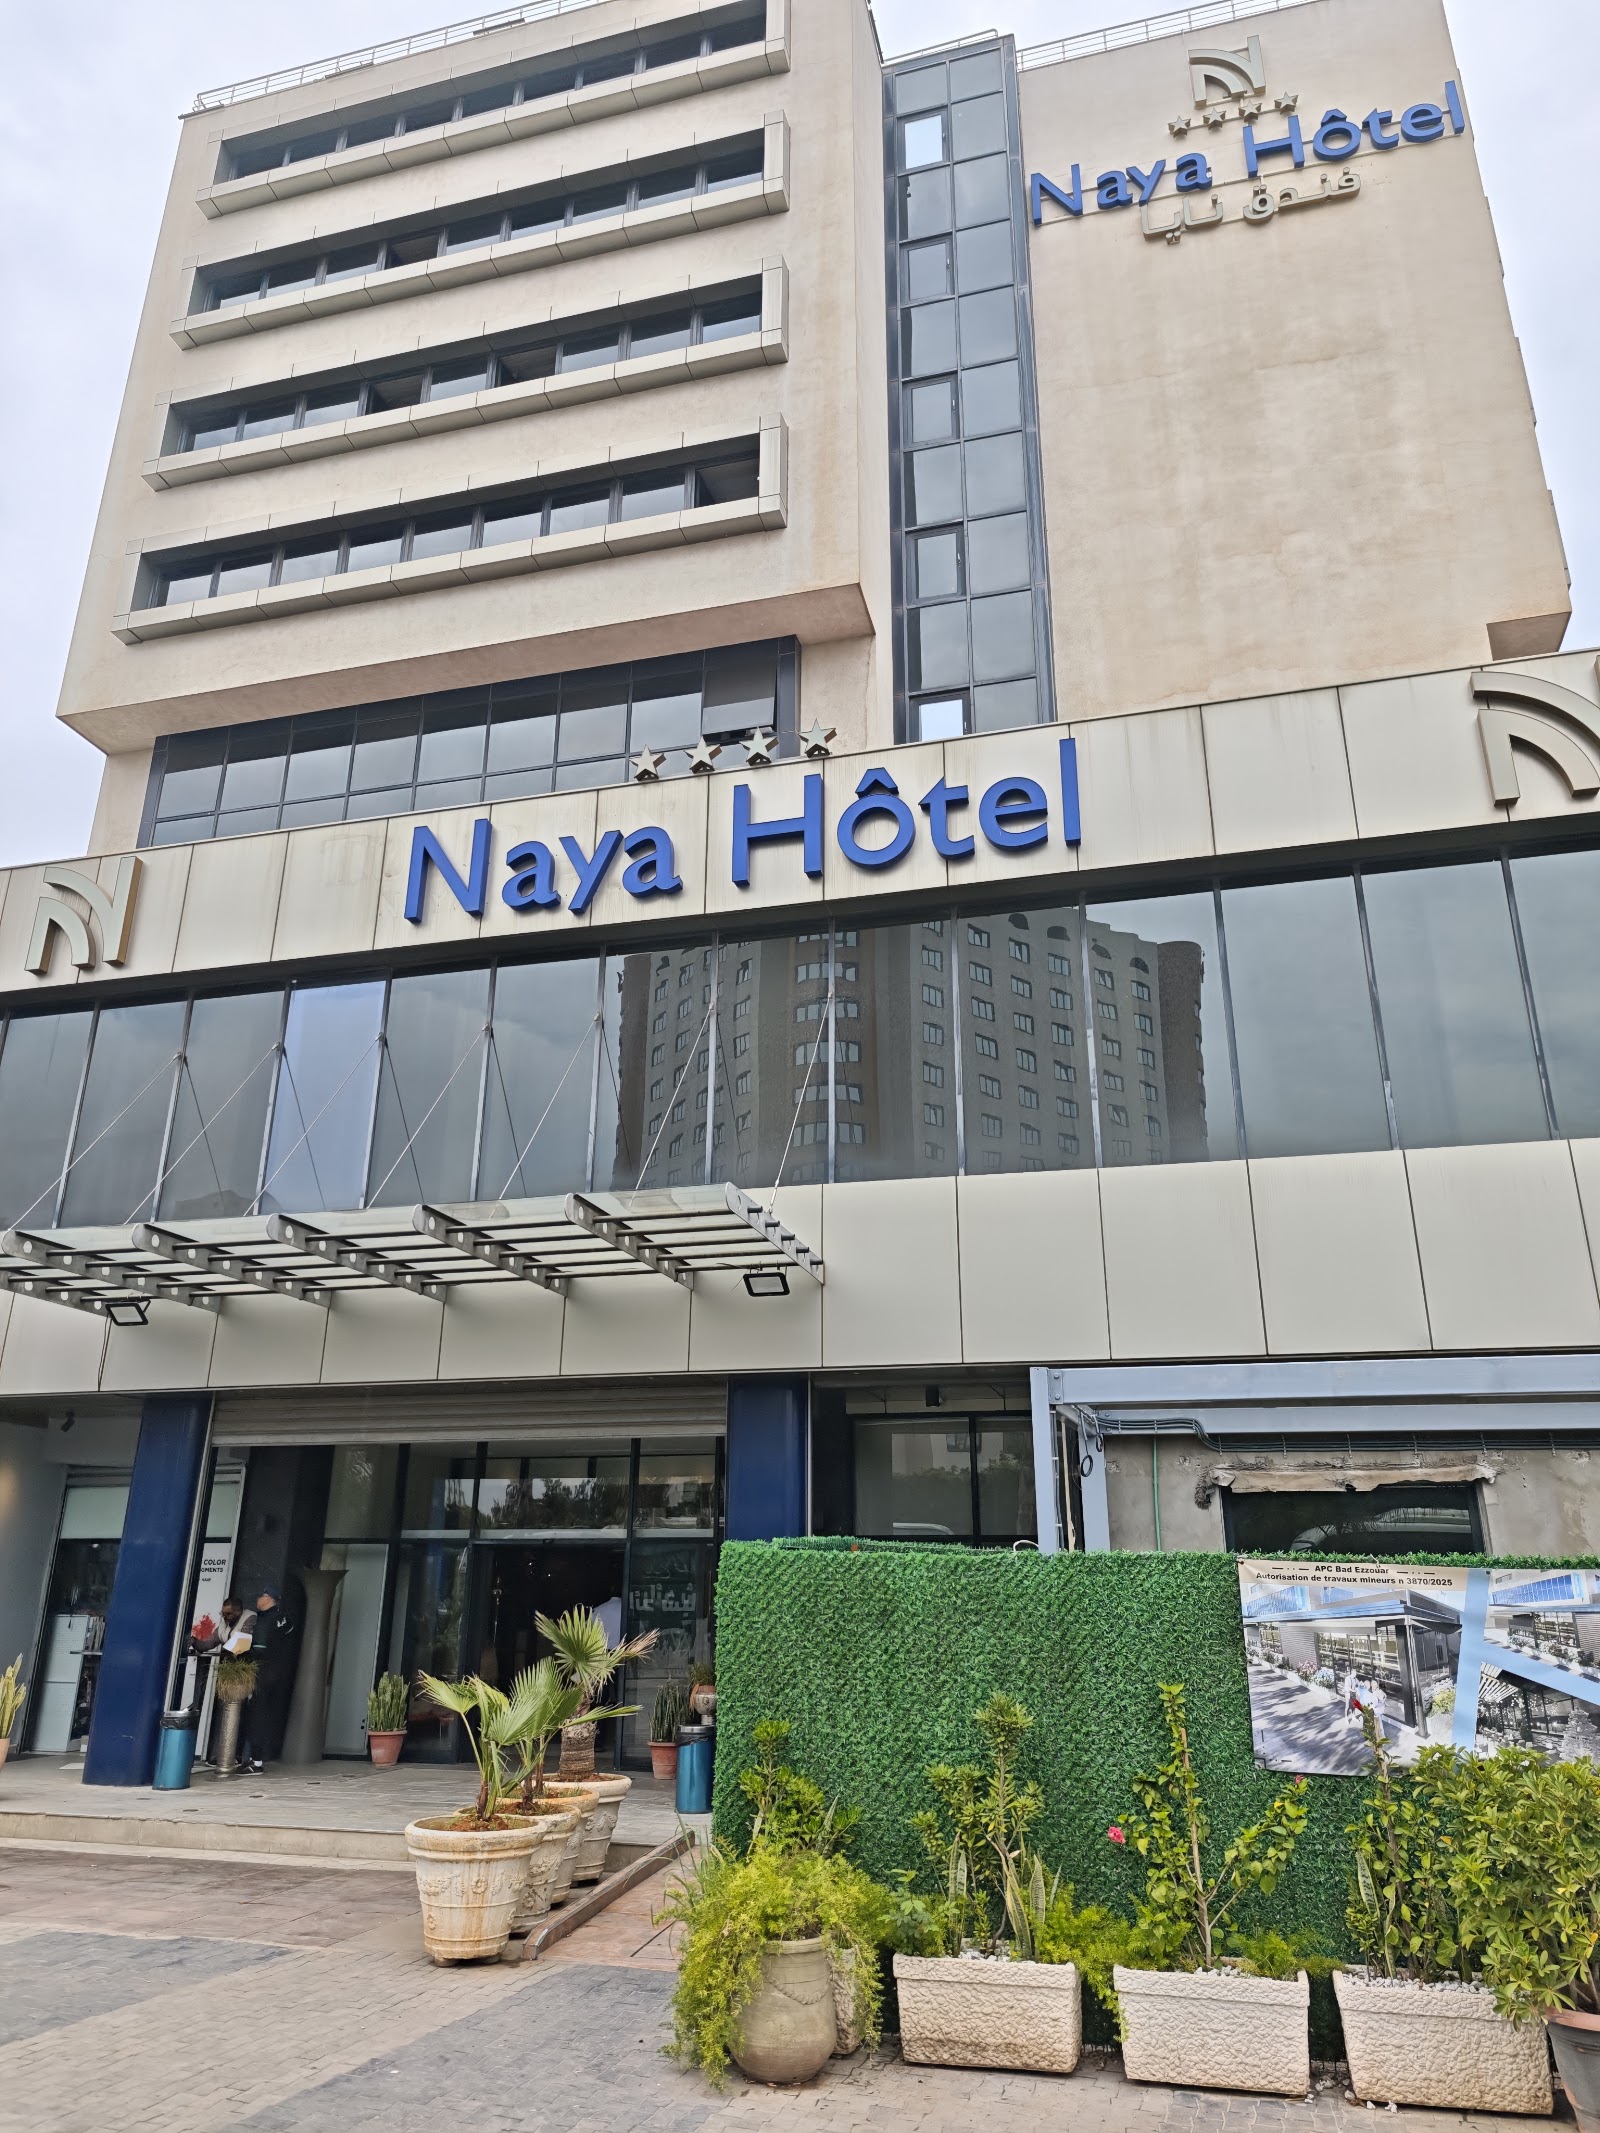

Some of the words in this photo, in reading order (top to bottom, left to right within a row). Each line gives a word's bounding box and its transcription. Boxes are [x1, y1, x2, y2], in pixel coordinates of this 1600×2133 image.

[1030, 152, 1212, 226] Naya
[1243, 80, 1466, 178] Hôtel
[1140, 194, 1224, 245] نايا
[1242, 167, 1361, 226] فندق
[404, 818, 683, 925] Naya
[732, 737, 1081, 888] Hôtel
[1256, 1572, 1309, 1581] Autorisation
[1311, 1574, 1322, 1582] de
[1323, 1575, 1358, 1583] travaux
[1359, 1576, 1396, 1584] mineurs
[1406, 1577, 1453, 1586] 3870/2025
[1314, 1565, 1333, 1573] APC
[1335, 1565, 1352, 1573] Bad
[1354, 1566, 1390, 1574] Ezzouar
